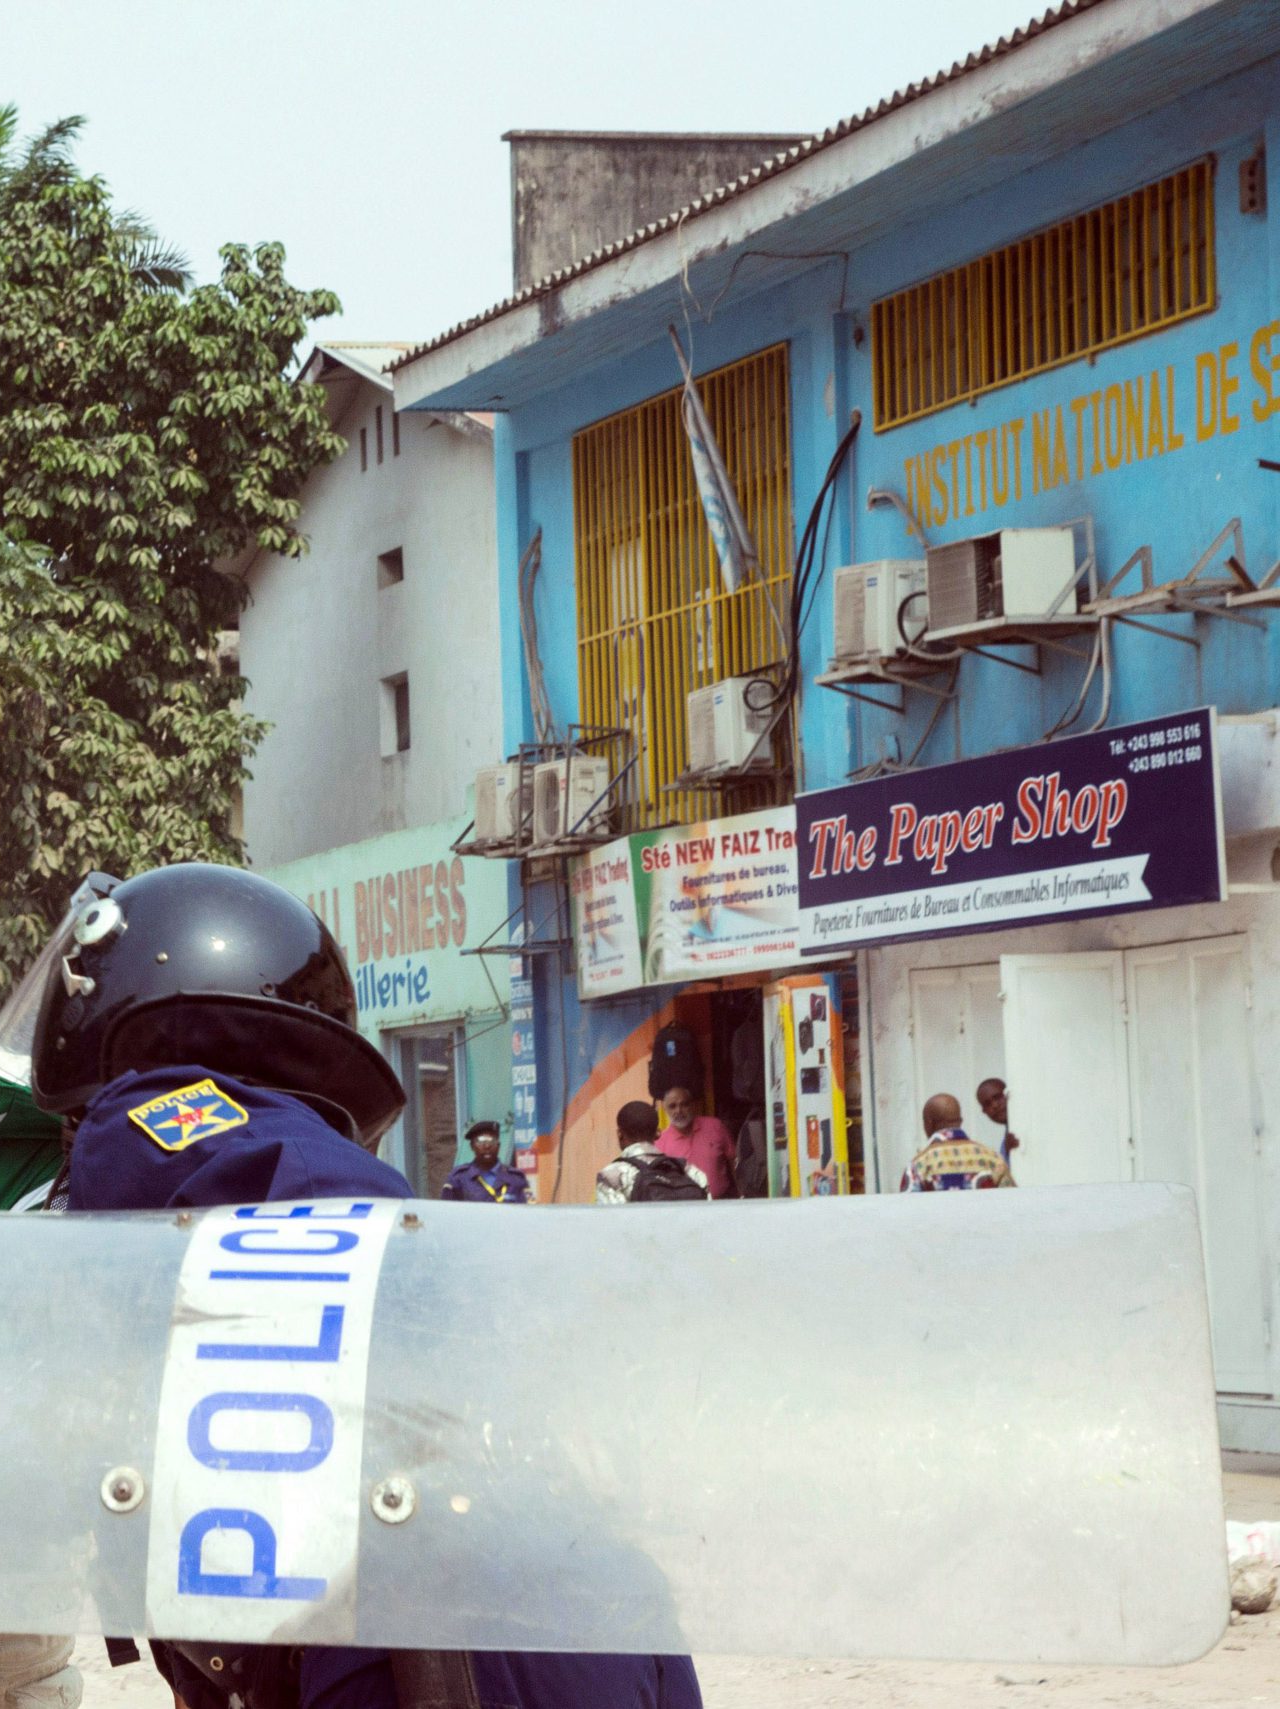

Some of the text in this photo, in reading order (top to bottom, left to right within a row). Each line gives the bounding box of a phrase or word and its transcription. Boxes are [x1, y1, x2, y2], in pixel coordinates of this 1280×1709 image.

[904, 418, 1024, 535] INSTITUT
[1032, 365, 1184, 495] NATIONAL
[1195, 342, 1240, 443] DE
[1127, 733, 1148, 752] +243
[1166, 726, 1183, 744] 553
[1184, 722, 1201, 741] 616
[1128, 755, 1149, 773] +243
[641, 840, 671, 872] Sté
[675, 837, 716, 866] NEW
[721, 828, 761, 858] FAIZ
[808, 770, 1128, 878] The Paper Shop
[669, 896, 697, 912] Outils
[767, 887, 774, 899] &
[682, 870, 737, 889] Fournitures
[739, 868, 751, 881] de
[812, 907, 854, 938] Papeterie
[855, 903, 908, 927] Fournitures
[910, 899, 922, 919] de
[923, 897, 960, 917] Bureau
[961, 896, 972, 911] et
[973, 882, 1051, 911] Consommables
[1052, 868, 1131, 907] Informatiques
[354, 856, 467, 964] BUSINESS
[177, 1202, 375, 1602] POLICE
